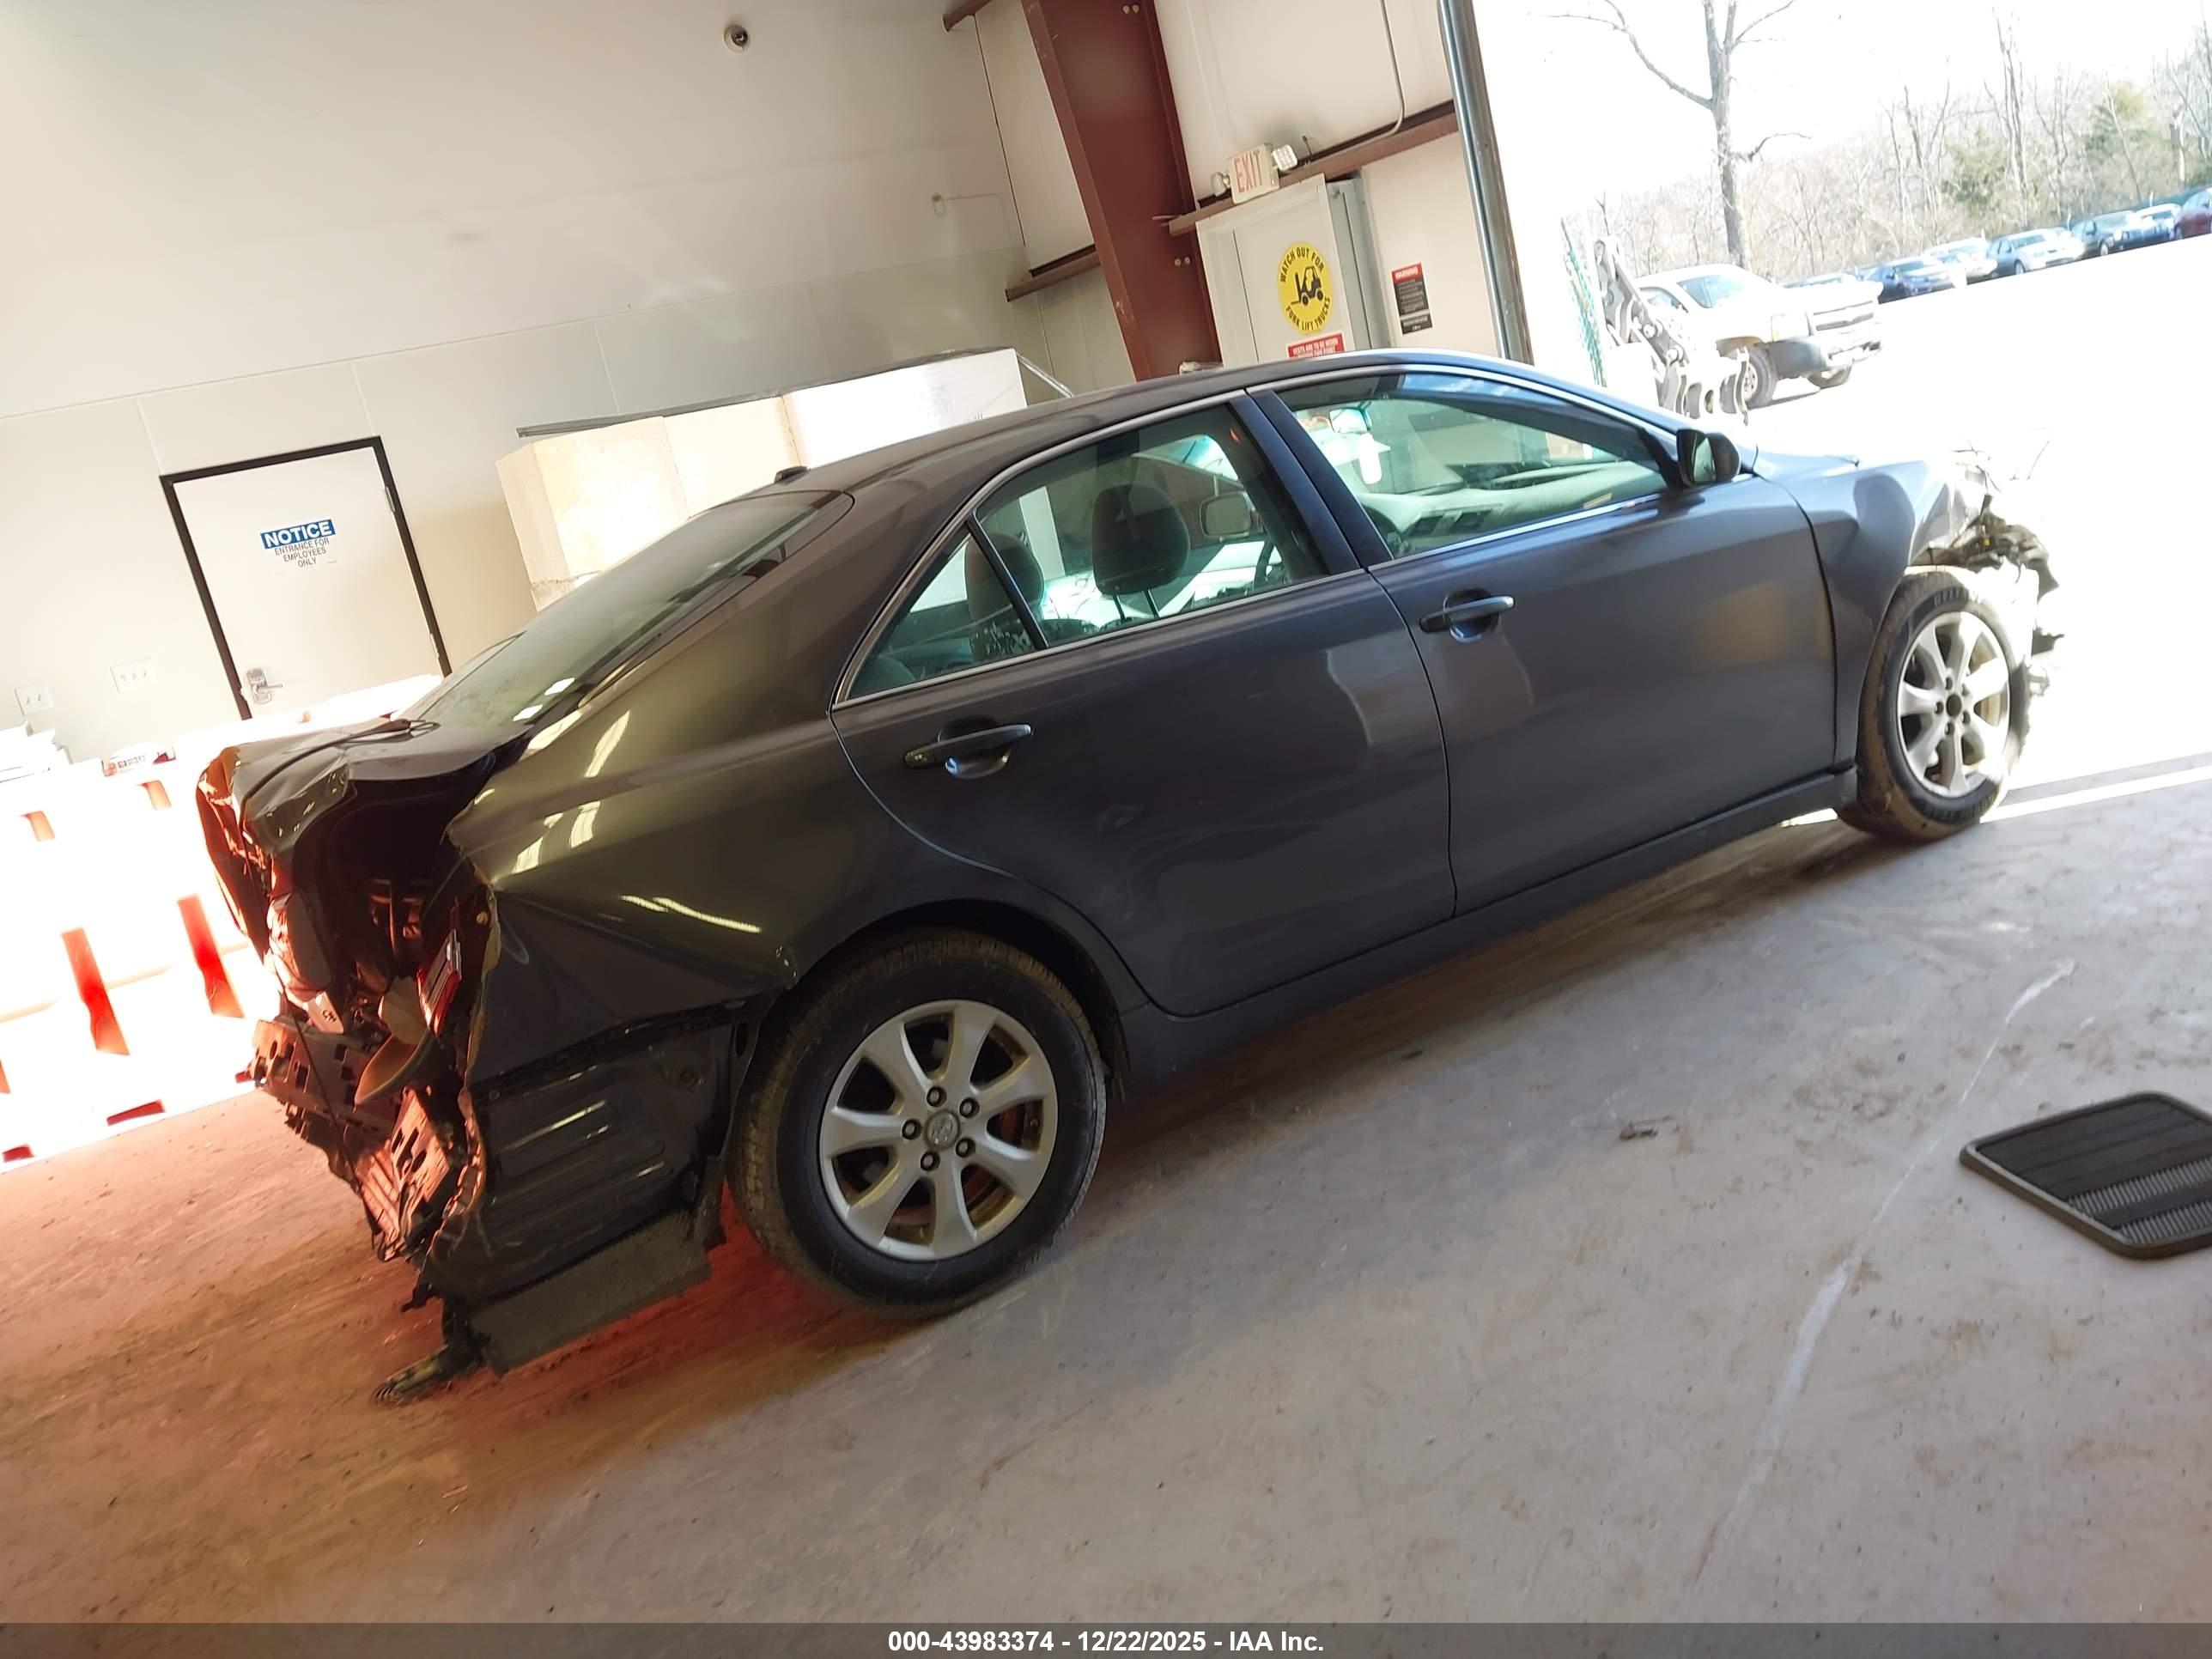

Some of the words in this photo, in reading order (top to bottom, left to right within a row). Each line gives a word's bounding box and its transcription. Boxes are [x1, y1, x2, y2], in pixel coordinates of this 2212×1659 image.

[1234, 149, 1262, 192] EXIT
[1280, 250, 1296, 283] WATCH
[1297, 247, 1310, 258] OUT
[1311, 252, 1324, 272] FOR
[1285, 305, 1300, 326] FORK
[1302, 321, 1314, 331] LIFT
[1315, 295, 1331, 327] TRUCKS
[264, 521, 331, 548] NOTICE
[274, 541, 314, 556] ENTRANCE
[314, 538, 330, 547] FOR
[283, 547, 326, 562] EMPLOYEES
[297, 557, 317, 568] ONLY
